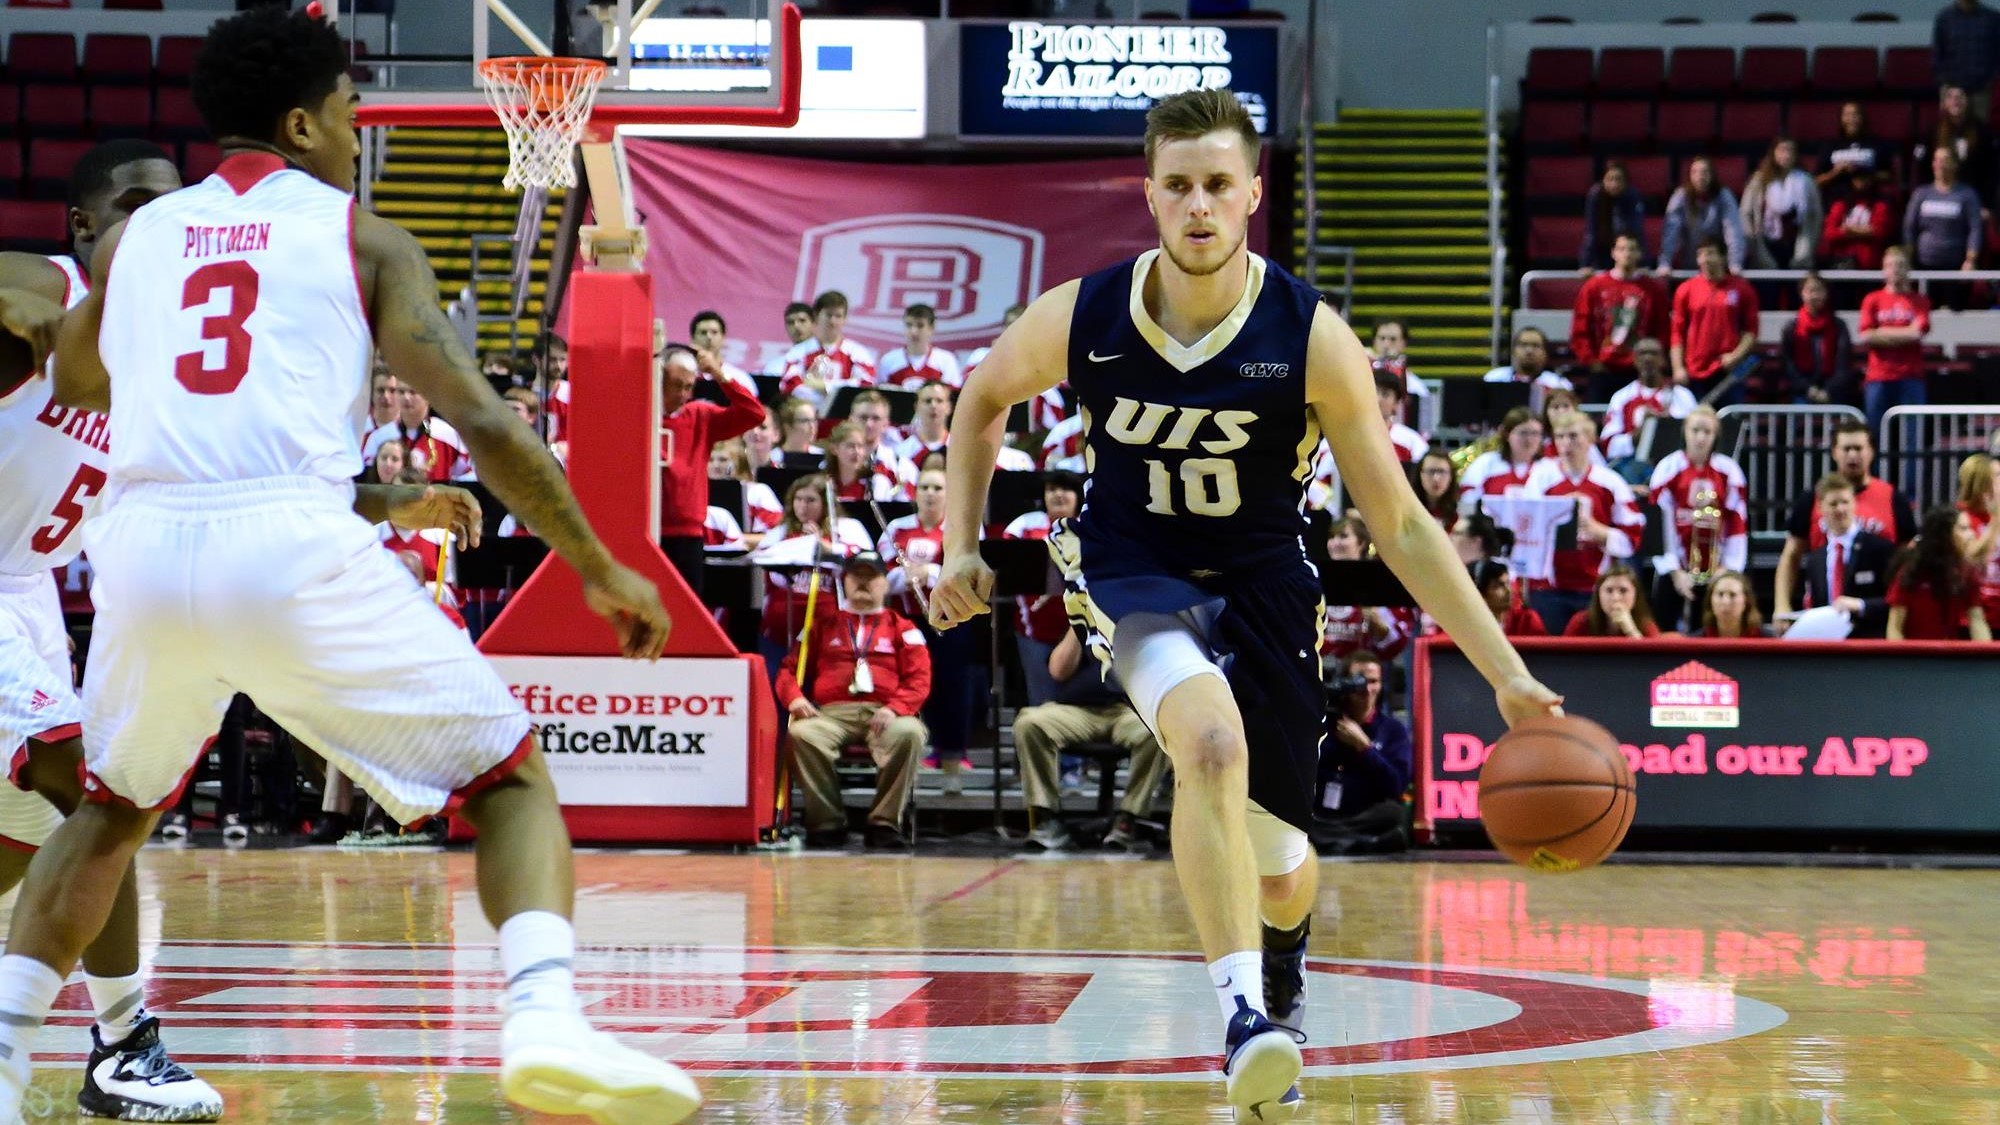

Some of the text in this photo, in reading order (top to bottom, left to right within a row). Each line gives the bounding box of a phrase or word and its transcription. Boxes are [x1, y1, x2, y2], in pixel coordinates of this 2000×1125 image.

[1008, 21, 1232, 63] PIONEER
[1002, 60, 1232, 98] RAILCORP
[183, 222, 271, 258] PITTMAN
[851, 243, 982, 319] B
[174, 260, 259, 395] 3
[1240, 362, 1289, 379] GLVC
[1105, 396, 1260, 455] UIS
[1143, 457, 1242, 517] 10
[31, 462, 107, 554] 5
[508, 685, 733, 716] fice DEPOT
[530, 722, 706, 754] ficeMax
[1715, 744, 1808, 776] our
[1812, 736, 1929, 777] APP
